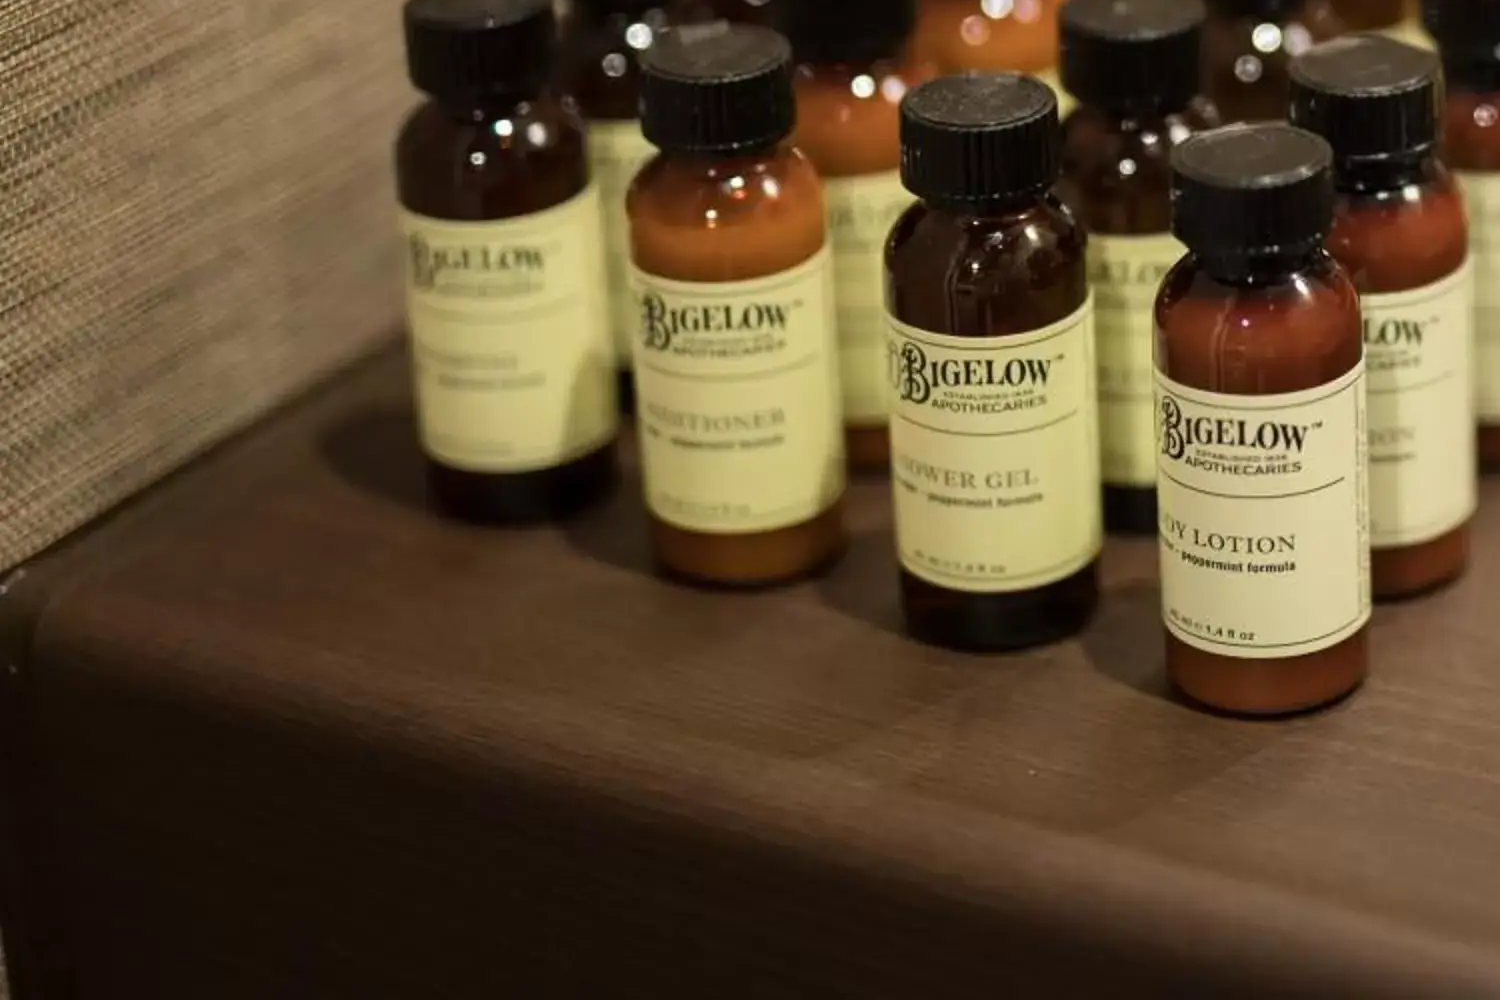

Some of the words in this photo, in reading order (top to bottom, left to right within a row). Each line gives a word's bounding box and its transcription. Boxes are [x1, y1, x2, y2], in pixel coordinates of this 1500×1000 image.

[643, 292, 790, 350] BIGELOW
[900, 342, 1051, 404] BIGELOW
[931, 396, 1048, 414] APOTHECARIES
[1162, 396, 1307, 459] BIGELOW
[984, 468, 1041, 489] GEL
[1185, 456, 1302, 476] APOTHECARIES
[1193, 527, 1296, 554] LOTION
[1181, 550, 1243, 573] peppermint
[1247, 561, 1296, 575] formula
